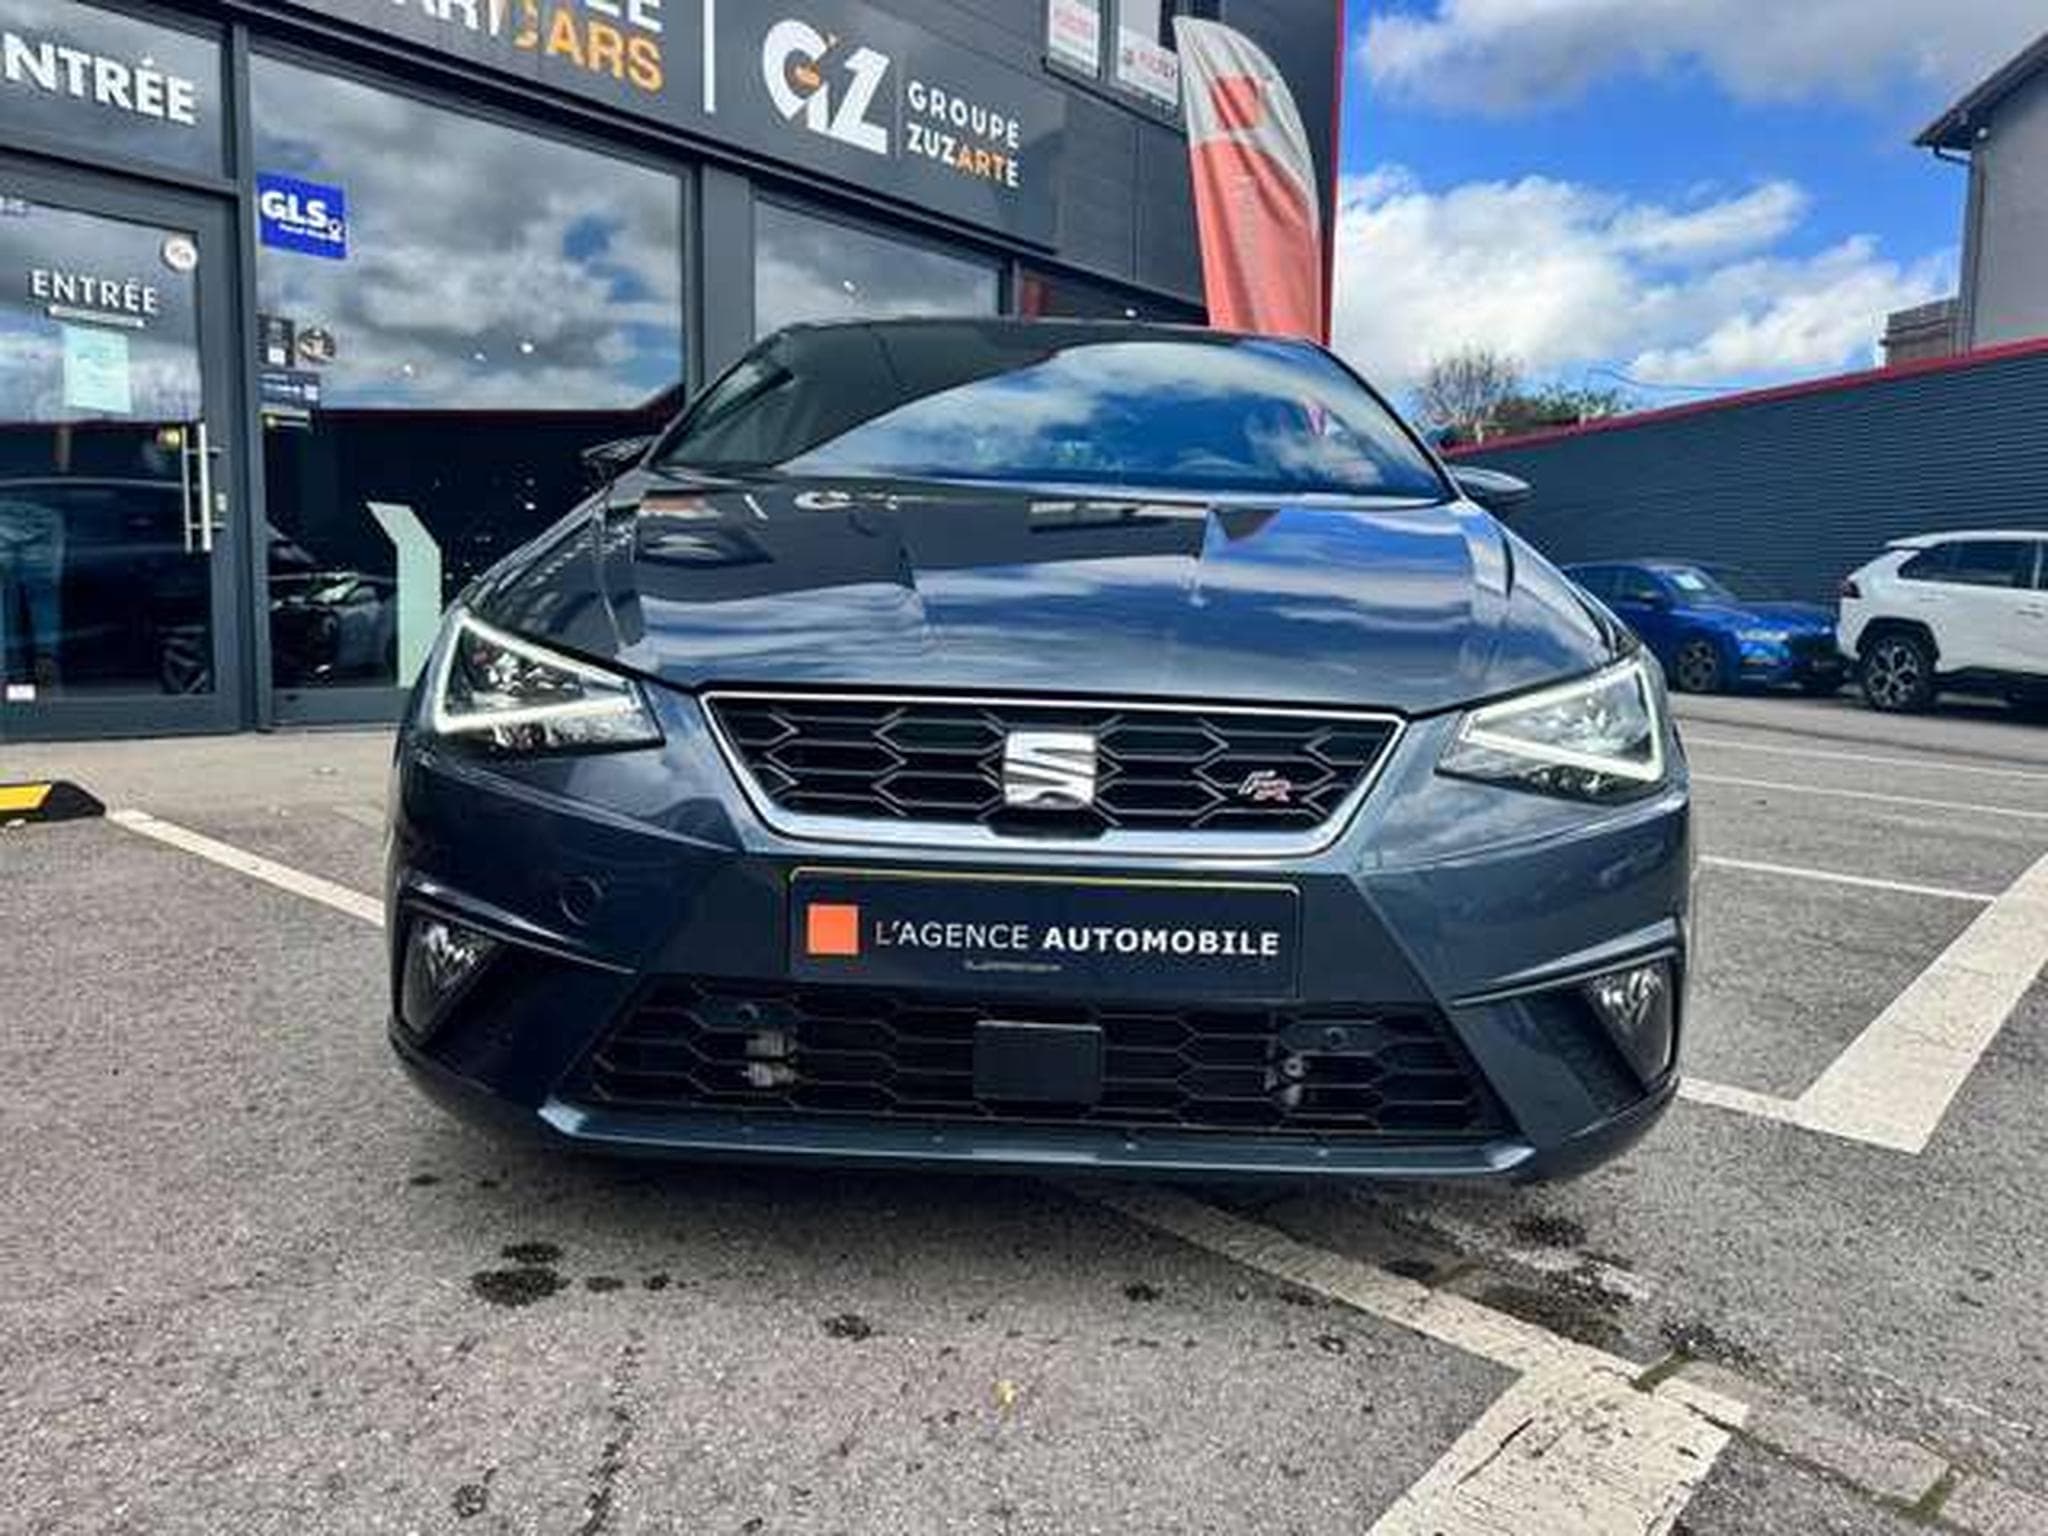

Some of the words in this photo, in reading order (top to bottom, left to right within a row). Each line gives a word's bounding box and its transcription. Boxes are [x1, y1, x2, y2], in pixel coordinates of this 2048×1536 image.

[3, 32, 196, 126] NTRÉE
[907, 80, 1020, 149] GROUPE
[906, 122, 1020, 188] ZUZARTE
[261, 190, 328, 228] GLS
[31, 269, 158, 314] ENTRÉE
[875, 921, 1029, 949] L'AGENCE
[1043, 926, 1280, 957] AUTOMOBILE
